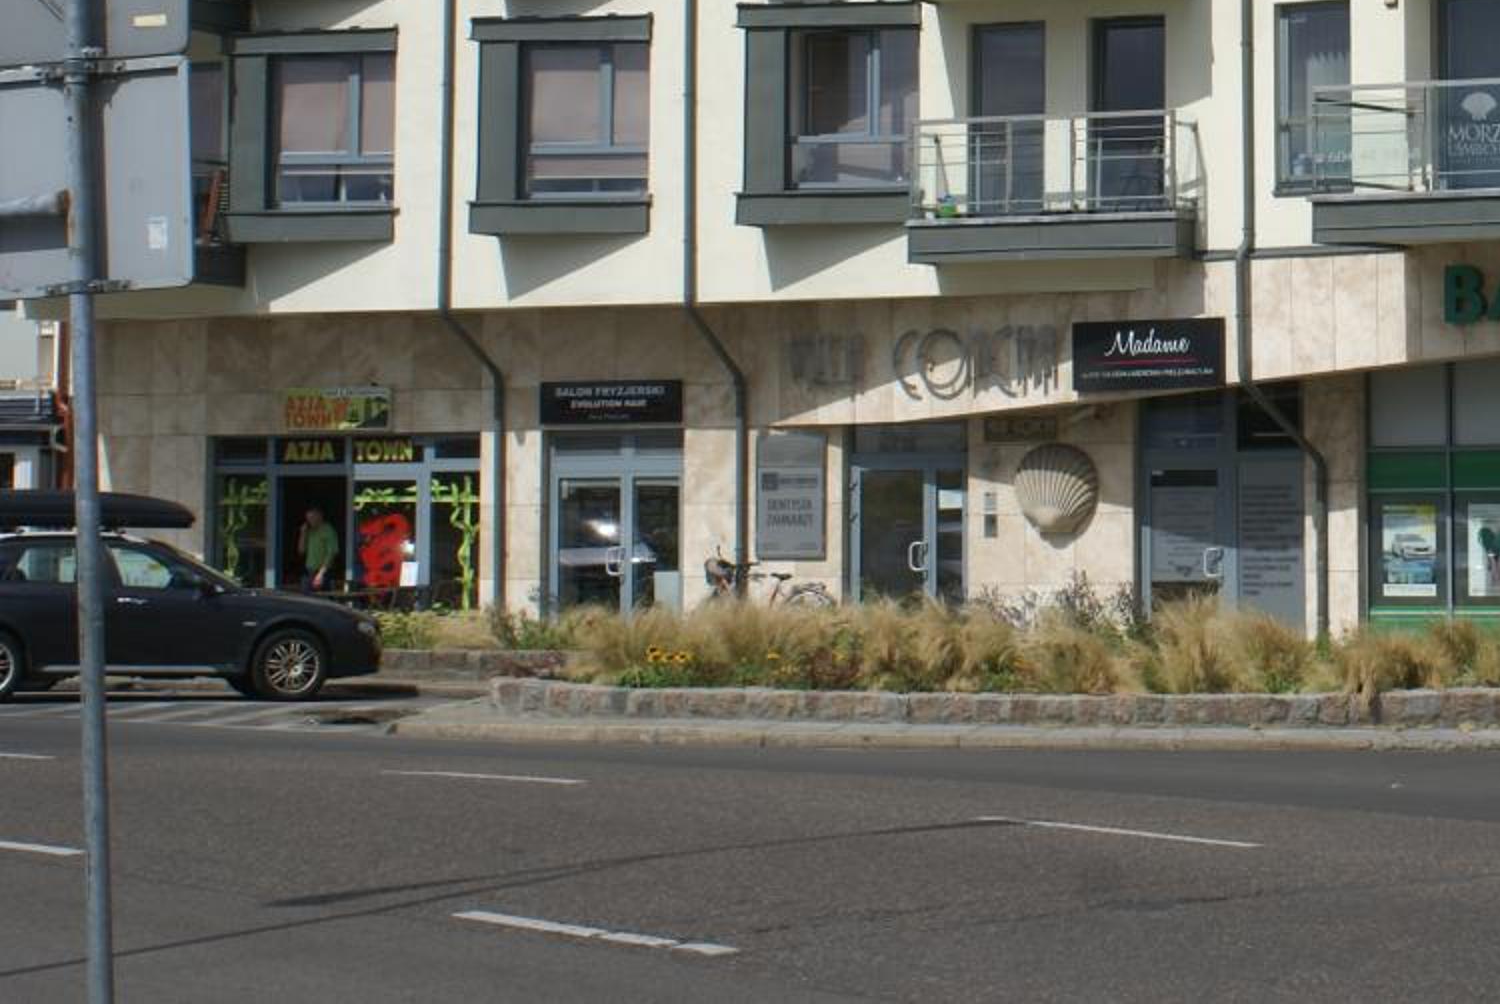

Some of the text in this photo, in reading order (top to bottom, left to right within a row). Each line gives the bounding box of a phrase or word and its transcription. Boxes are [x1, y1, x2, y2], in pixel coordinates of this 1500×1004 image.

[1104, 328, 1190, 356] Madame
[556, 387, 592, 397] SALON
[285, 439, 413, 462] AZJA TOWN
